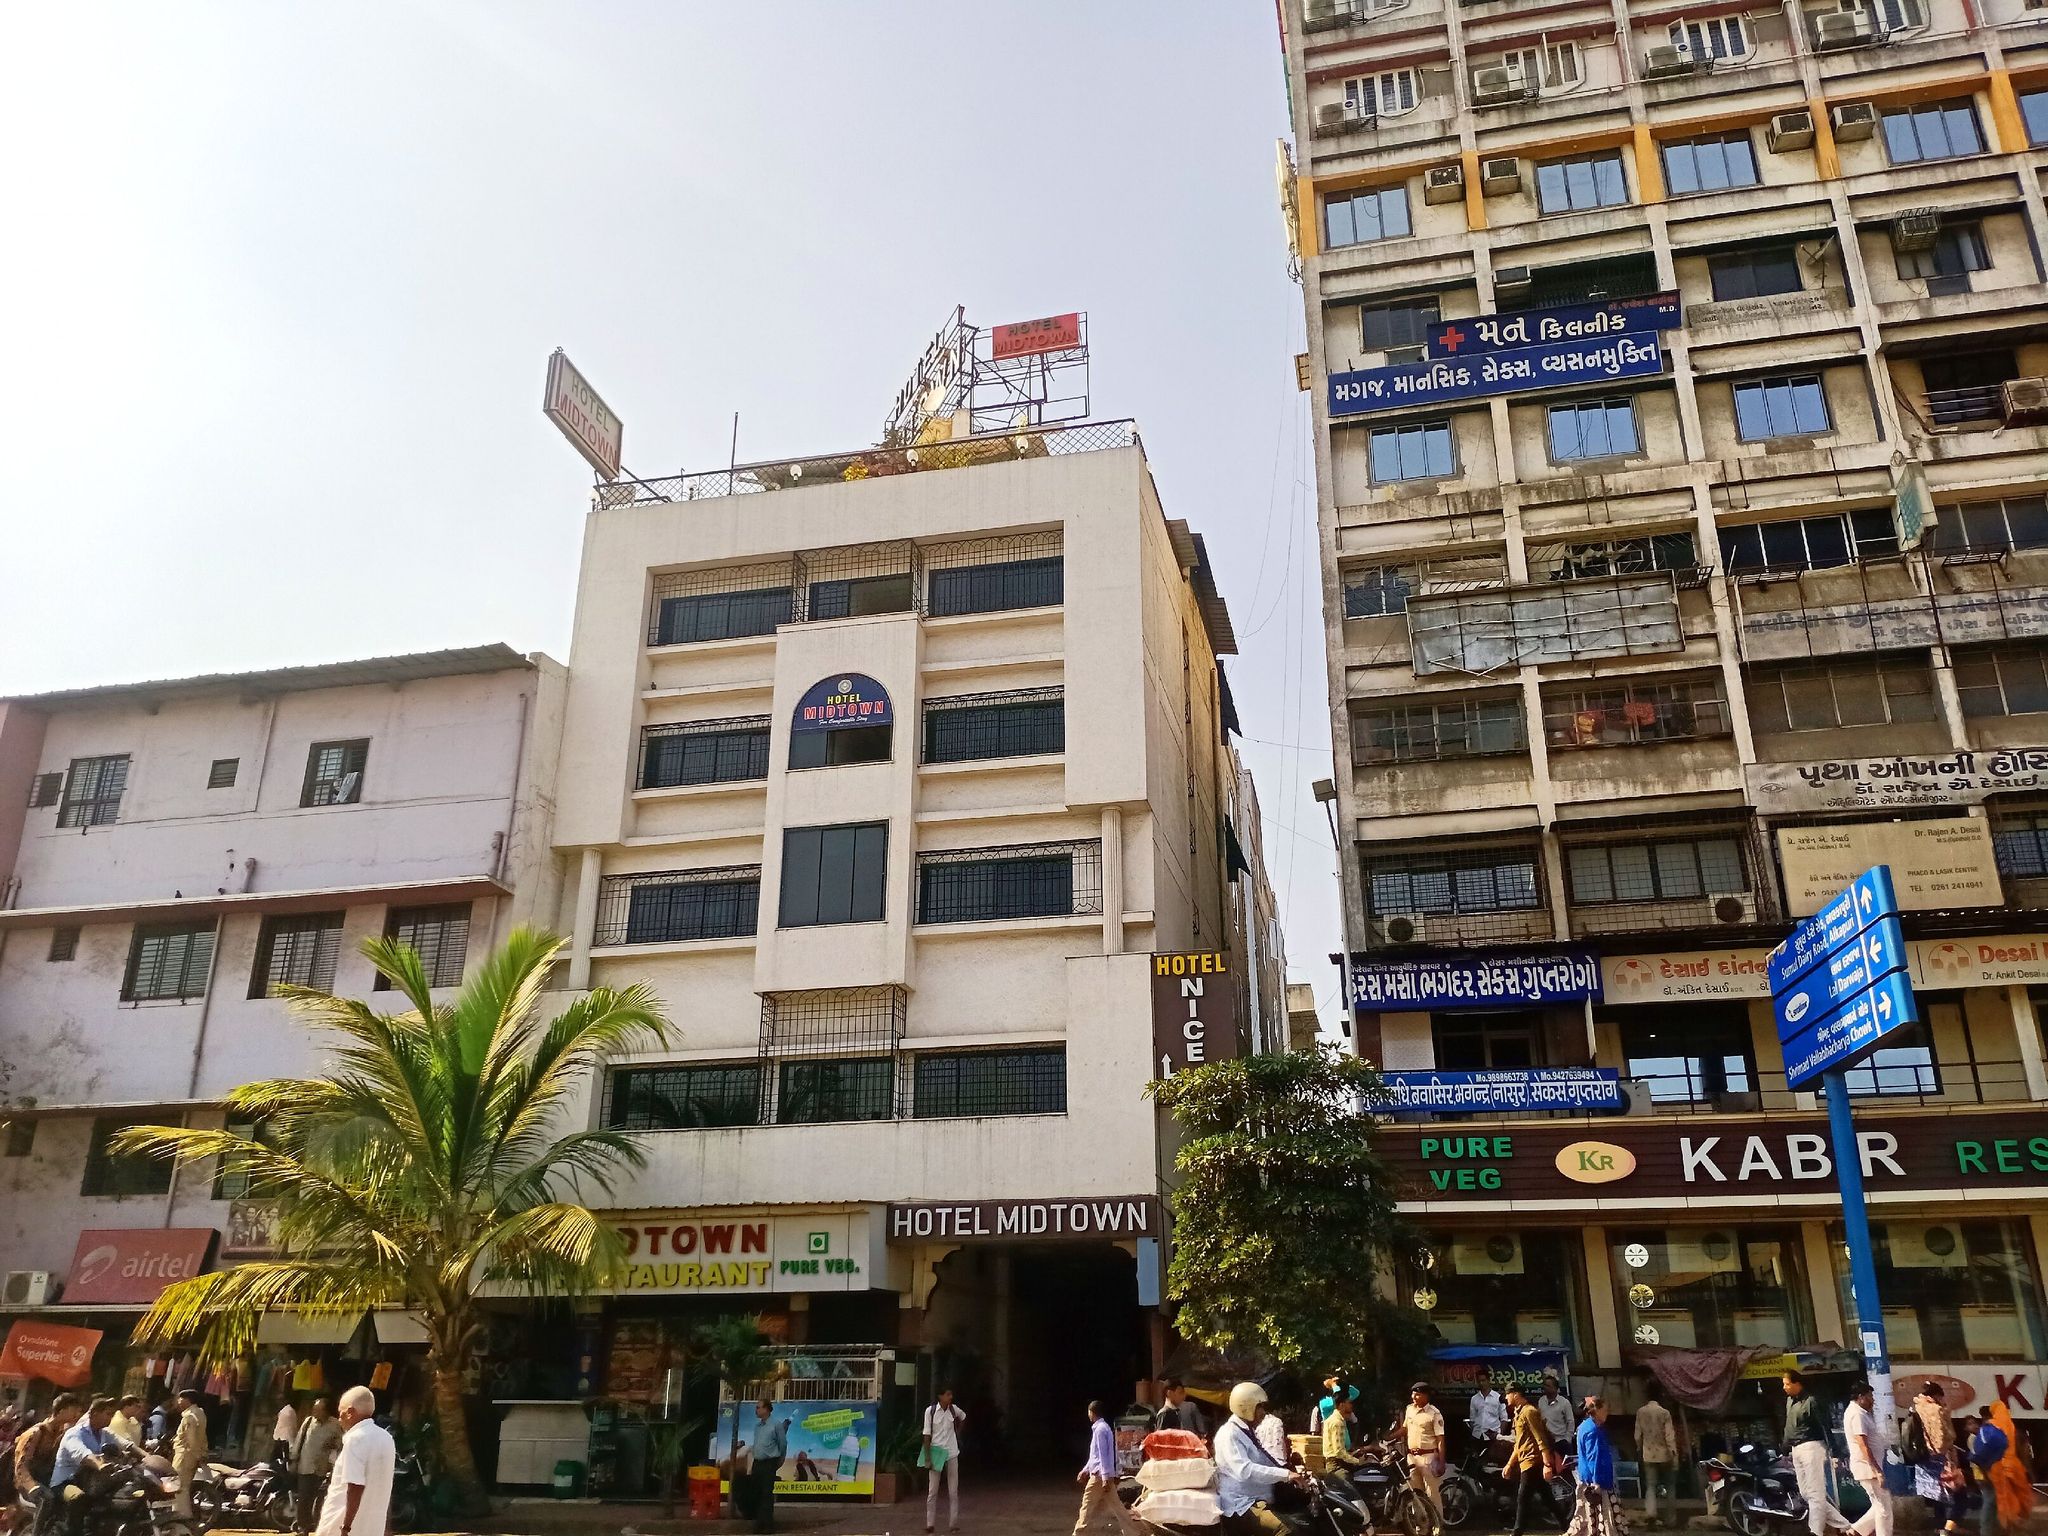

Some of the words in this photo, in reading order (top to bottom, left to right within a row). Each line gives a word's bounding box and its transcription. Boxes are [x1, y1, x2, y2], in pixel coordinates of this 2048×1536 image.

[1659, 305, 1678, 313] M.D.
[1008, 317, 1062, 337] HOTEL
[994, 328, 1077, 353] MIDTOWN
[571, 375, 609, 433] HOTEL
[558, 393, 617, 469] MIDTOWN
[827, 693, 862, 705] HOTEL
[804, 701, 884, 720] MIDTOWN
[1868, 752, 1975, 780] આંખની
[1914, 829, 1927, 837] Dr.
[1927, 828, 1949, 837] Rajen
[1950, 827, 1959, 835] A.
[1960, 825, 1981, 834] Desai
[1907, 869, 1929, 877] PHACO
[1935, 868, 1954, 876] LASIK
[1954, 866, 1979, 874] CENTRE
[1909, 884, 1924, 893] TEL
[1931, 883, 1950, 891] 0261
[1951, 881, 1984, 890] 2414941
[1781, 956, 1799, 980] Sumul
[1797, 948, 1813, 969] Dairy
[1811, 934, 1830, 956] Road,
[1829, 913, 1855, 944] Alkapuri
[1978, 942, 2039, 963] Desai
[1156, 953, 1226, 976] HOTEL
[1660, 957, 1710, 978] દેસાઈ
[1982, 971, 1995, 980] Dr.
[1996, 969, 2016, 980] Ankit
[2017, 968, 2042, 979] Desai
[1705, 981, 1730, 994] દેસાઈ
[1827, 981, 1839, 999] Lal
[1838, 965, 1864, 993] Darwaja
[1180, 977, 1205, 1062] NICE
[1788, 1054, 1810, 1081] Shrimad
[1808, 1032, 1851, 1067] Vallabhacharya
[1850, 1018, 1873, 1043] Chowk
[1421, 1137, 1513, 1159] PURE
[1680, 1131, 1907, 1182] KABR
[1578, 1150, 1615, 1171] KR
[1429, 1168, 1502, 1190] VEG
[894, 1206, 990, 1237] HOTEL
[997, 1201, 1148, 1235] MIDTOWN
[120, 1249, 194, 1279] airtel
[780, 1258, 820, 1276] PURE
[824, 1257, 861, 1275] VEG.
[16, 1345, 64, 1364] SuperNet
[1751, 1358, 1784, 1367] HEMANT
[789, 1484, 838, 1492] RESTAURANT
